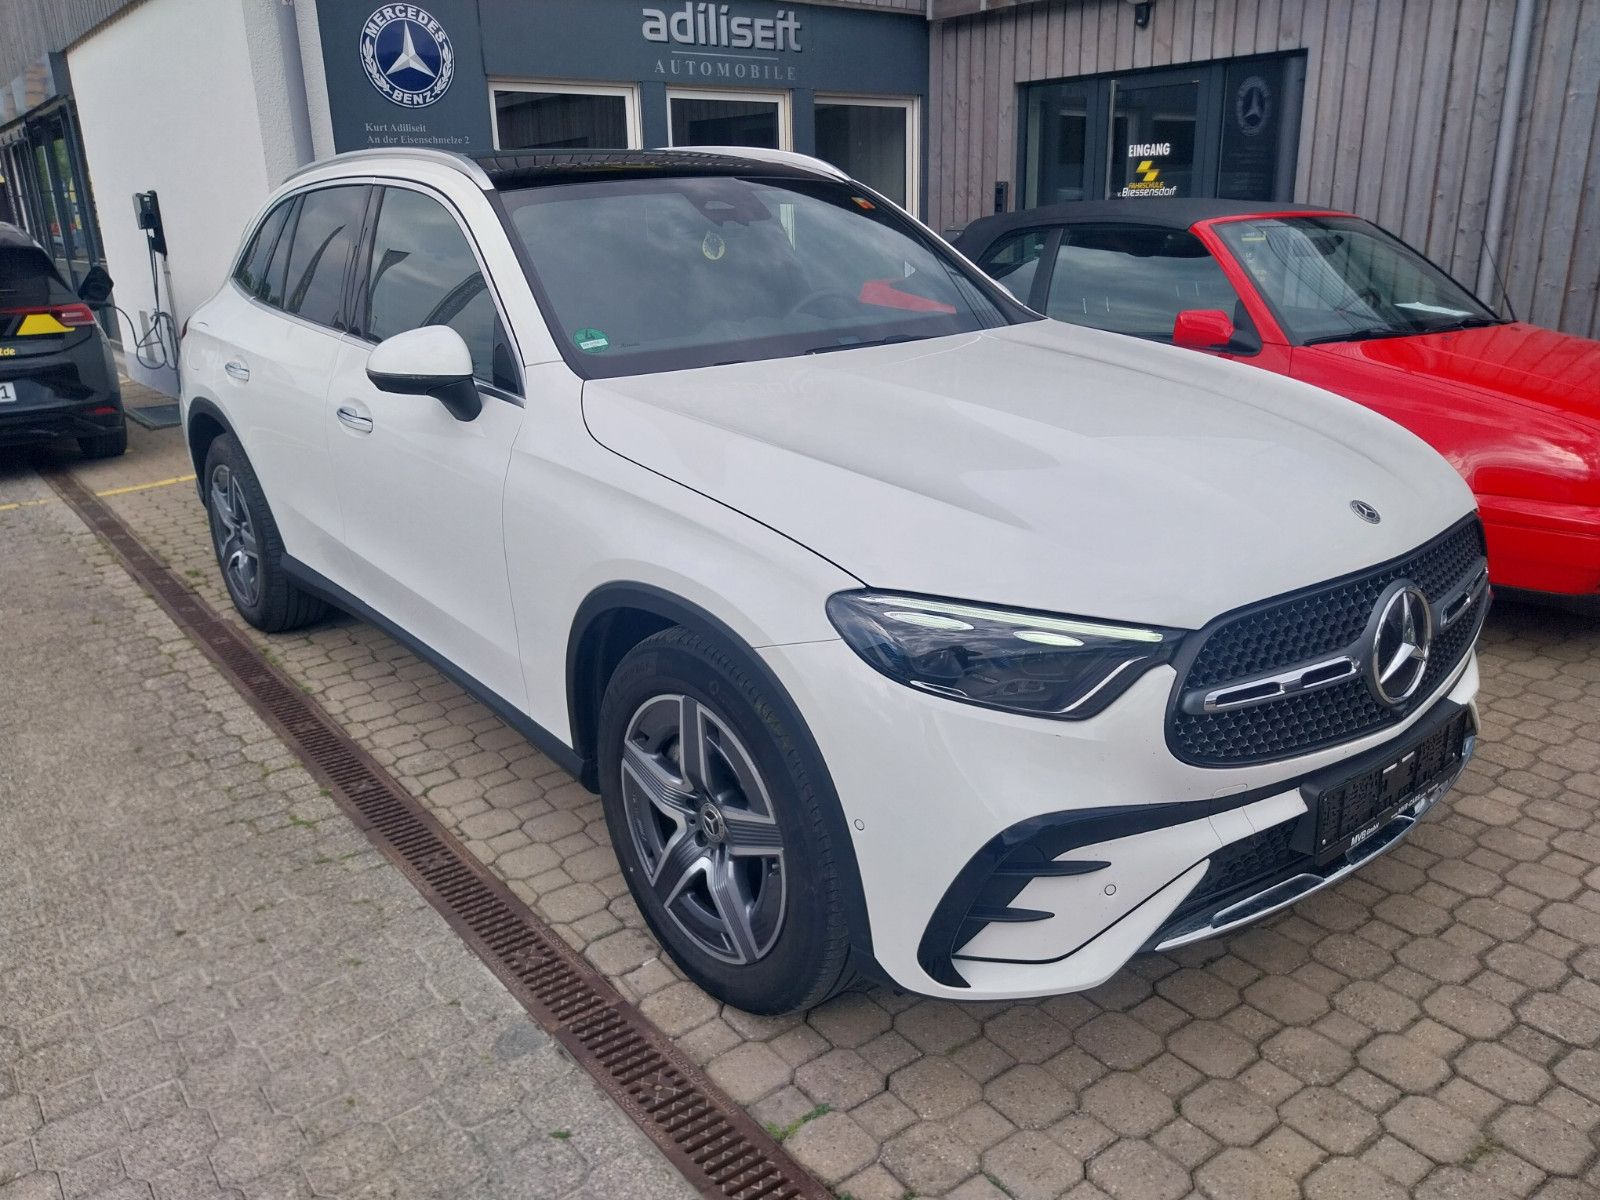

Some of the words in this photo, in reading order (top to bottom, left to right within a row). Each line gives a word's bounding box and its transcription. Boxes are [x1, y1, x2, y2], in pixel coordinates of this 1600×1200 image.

[364, 5, 446, 43] MERCEDES
[654, 59, 796, 81] AUTOMOBILE
[392, 90, 434, 105] BENZ
[365, 122, 388, 132] Kurt
[367, 135, 380, 144] An
[383, 135, 398, 144] der
[464, 136, 470, 144] 2
[1128, 143, 1170, 157] EINGANG
[1351, 829, 1366, 846] MVB
